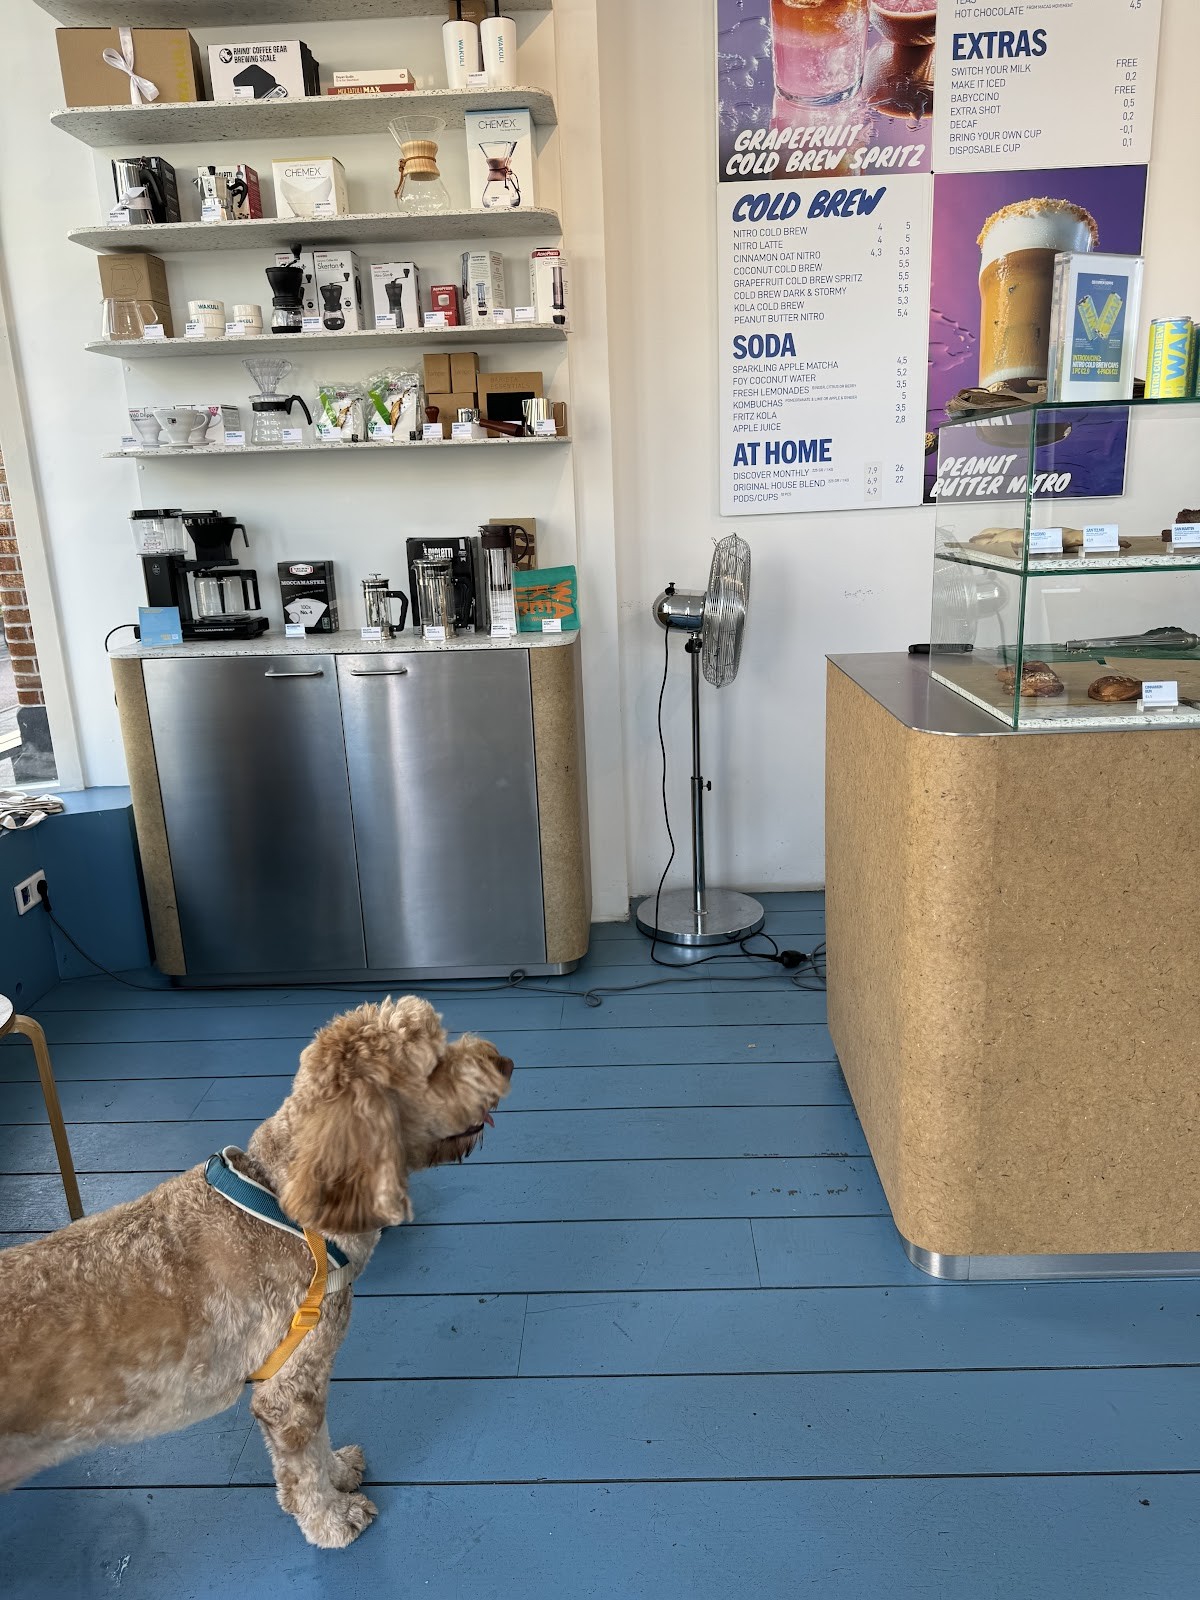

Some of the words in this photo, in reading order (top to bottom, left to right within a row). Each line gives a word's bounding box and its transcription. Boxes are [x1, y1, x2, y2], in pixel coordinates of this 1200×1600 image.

[1130, 1, 1142, 9] 4,5
[954, 9, 972, 18] HOT
[974, 6, 1024, 18] CHOCOLATE
[952, 29, 1047, 60] EXTRAS
[253, 46, 272, 54] COFFEE
[1116, 58, 1138, 68] FREE
[951, 66, 983, 76] SWITCH
[985, 65, 1008, 75] YOUR
[1010, 64, 1031, 73] MILK
[1125, 72, 1136, 82] 0,2
[951, 80, 975, 89] MAKE
[977, 80, 985, 88] IT
[986, 79, 1006, 88] ICED
[1114, 85, 1136, 94] FREE
[951, 92, 1000, 102] BABYCCINO
[1123, 99, 1135, 108] 0,5
[950, 107, 977, 116] EXTRA
[979, 105, 1001, 114] SHOT
[1122, 112, 1134, 121] 0,2
[478, 119, 516, 129] CHEMEX
[950, 120, 978, 129] DECAF
[1120, 125, 1133, 134] -0,1
[734, 124, 864, 152] GRAPEFRUIT
[950, 133, 976, 142] BRING
[978, 132, 1000, 141] YOUR
[1002, 131, 1022, 140] OWN
[1024, 130, 1042, 139] CUP
[1122, 138, 1132, 147] 0,1
[950, 145, 1001, 155] DISPOSABLE
[1003, 144, 1020, 153] CUP
[726, 152, 780, 175] COLD
[785, 149, 847, 173] BREW
[850, 144, 926, 170] SPRITZ
[284, 167, 321, 178] CHEMEX
[732, 191, 802, 223] COLD
[807, 186, 887, 219] BREW
[733, 228, 757, 238] NITRO
[759, 228, 782, 237] COLD
[784, 226, 808, 236] BREW
[878, 223, 882, 231] 4
[906, 234, 910, 242] 5
[733, 241, 757, 251] NITRO
[759, 240, 783, 249] LATTE
[870, 248, 882, 258] 4,3
[899, 247, 910, 256] 5,3
[733, 253, 778, 263] CINNAMON
[780, 252, 795, 261] OAT
[797, 251, 820, 260] NITRO
[899, 260, 910, 268] 5,5
[733, 266, 773, 276] COCONUT
[774, 265, 797, 274] COLD
[799, 263, 823, 272] BREW
[734, 277, 784, 288] GRAPEFRUIT
[786, 276, 808, 285] COLD
[810, 275, 834, 284] BREW
[835, 273, 863, 283] SPRITZ
[898, 272, 909, 281] 5,5
[734, 291, 755, 300] COLD
[757, 290, 782, 299] BREW
[783, 289, 806, 298] DARK
[807, 289, 812, 297] &
[815, 287, 847, 296] STORMY
[898, 284, 909, 293] 5,5
[898, 296, 908, 305] 5,3
[734, 303, 755, 312] KOLA
[757, 302, 779, 311] COLD
[781, 301, 805, 310] BREW
[734, 315, 766, 324] PEANUT
[768, 314, 798, 323] BUTTER
[800, 312, 824, 321] NITRO
[897, 309, 908, 318] 5,4
[1155, 326, 1164, 350] BREW
[733, 332, 797, 359] SODA
[897, 356, 908, 365] 4,5
[1153, 351, 1162, 372] COLD
[732, 364, 777, 374] SPARKLING
[779, 362, 804, 372] APPLE
[806, 361, 838, 370] MATCHA
[896, 368, 907, 377] 5,2
[733, 377, 748, 385] FOY
[750, 375, 788, 385] COCONUT
[790, 374, 816, 383] WATER
[896, 380, 907, 389] 3,5
[1151, 373, 1160, 397] NITRO
[733, 389, 759, 397] FRESH
[760, 386, 809, 396] LEMONADES
[733, 399, 783, 409] KOMBUCHAS
[895, 404, 906, 412] 3,5
[733, 412, 754, 421] FRITZ
[756, 411, 777, 420] KOLA
[895, 416, 906, 424] 2,8
[733, 424, 758, 432] APPLE
[760, 423, 781, 432] JUICE
[733, 442, 760, 467] AT
[765, 438, 832, 465] HOME
[895, 464, 904, 472] 26
[938, 454, 1018, 477] PEANUT
[734, 470, 771, 480] DISCOVER
[773, 469, 809, 478] MONTHLY
[734, 482, 769, 492] ORIGINAL
[771, 481, 797, 490] HOUSE
[799, 479, 825, 488] BLEND
[867, 477, 877, 485] 6,9
[930, 475, 1004, 497] BUTTER
[867, 487, 877, 495] 4,9
[734, 493, 778, 503] PODS/CUPS
